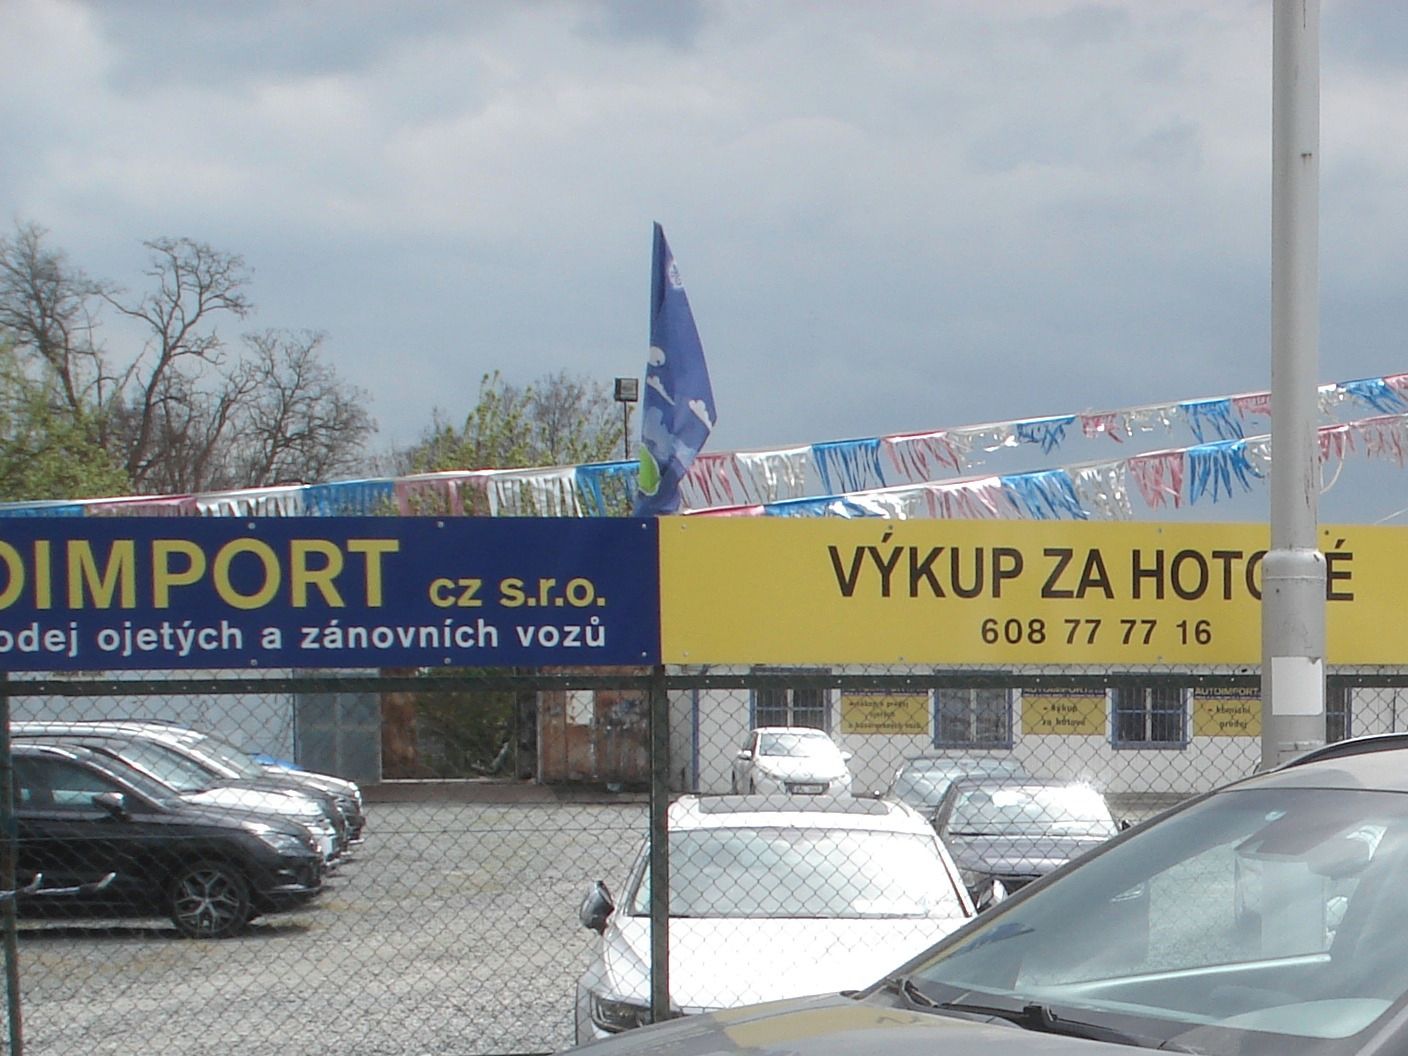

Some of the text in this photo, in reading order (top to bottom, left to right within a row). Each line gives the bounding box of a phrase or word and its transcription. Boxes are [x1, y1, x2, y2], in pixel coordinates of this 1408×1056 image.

[828, 532, 1023, 599] VÝKUP
[1041, 547, 1114, 600] ZA
[429, 578, 482, 607] cz
[500, 577, 606, 607] s.r.o.
[97, 620, 242, 657] ojetých
[262, 627, 281, 649] a
[301, 619, 498, 649] zánovních
[516, 616, 605, 647] vozů
[981, 618, 1211, 646] 608 77 77 16
